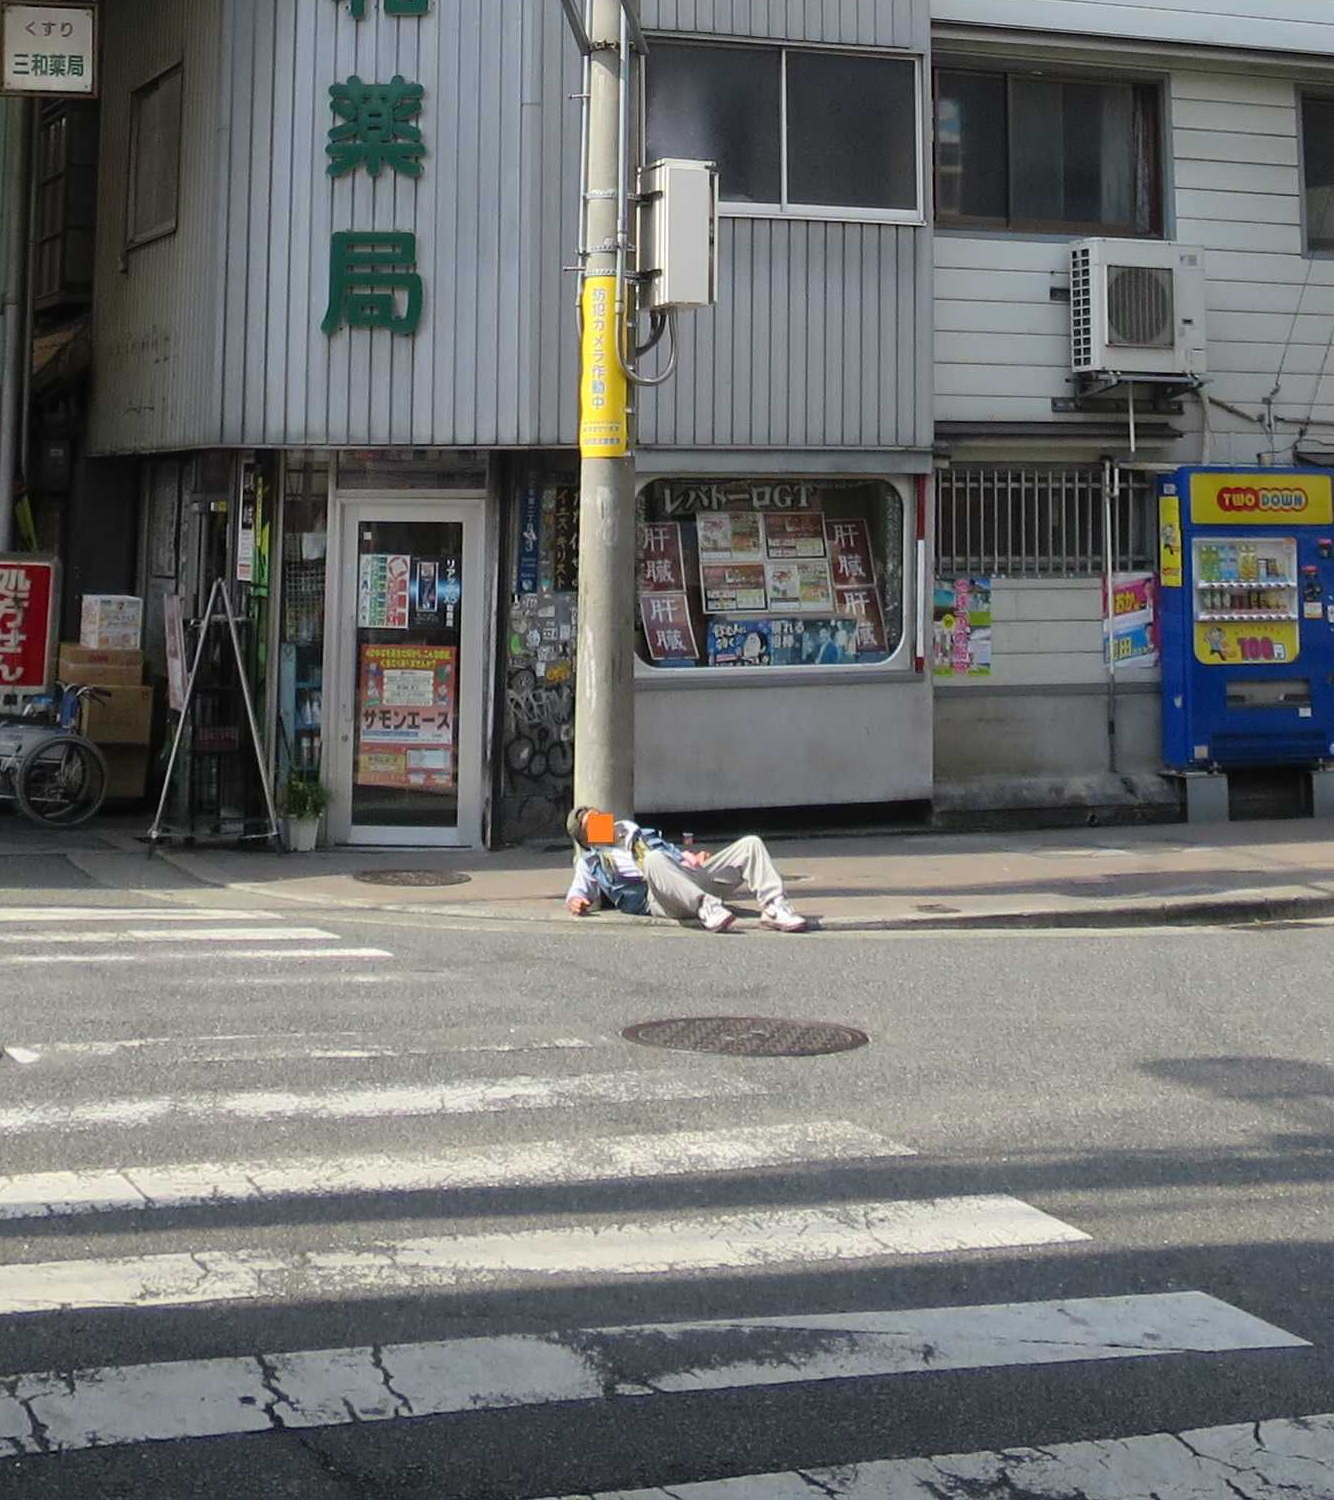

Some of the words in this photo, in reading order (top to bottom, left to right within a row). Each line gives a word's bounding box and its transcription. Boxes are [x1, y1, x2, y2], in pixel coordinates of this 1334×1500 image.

[24, 21, 74, 38] くすり
[12, 53, 85, 78] 三和薬局
[1220, 489, 1258, 510] TWO
[1259, 490, 1307, 510] DOWN
[362, 708, 451, 731] サモンエース
